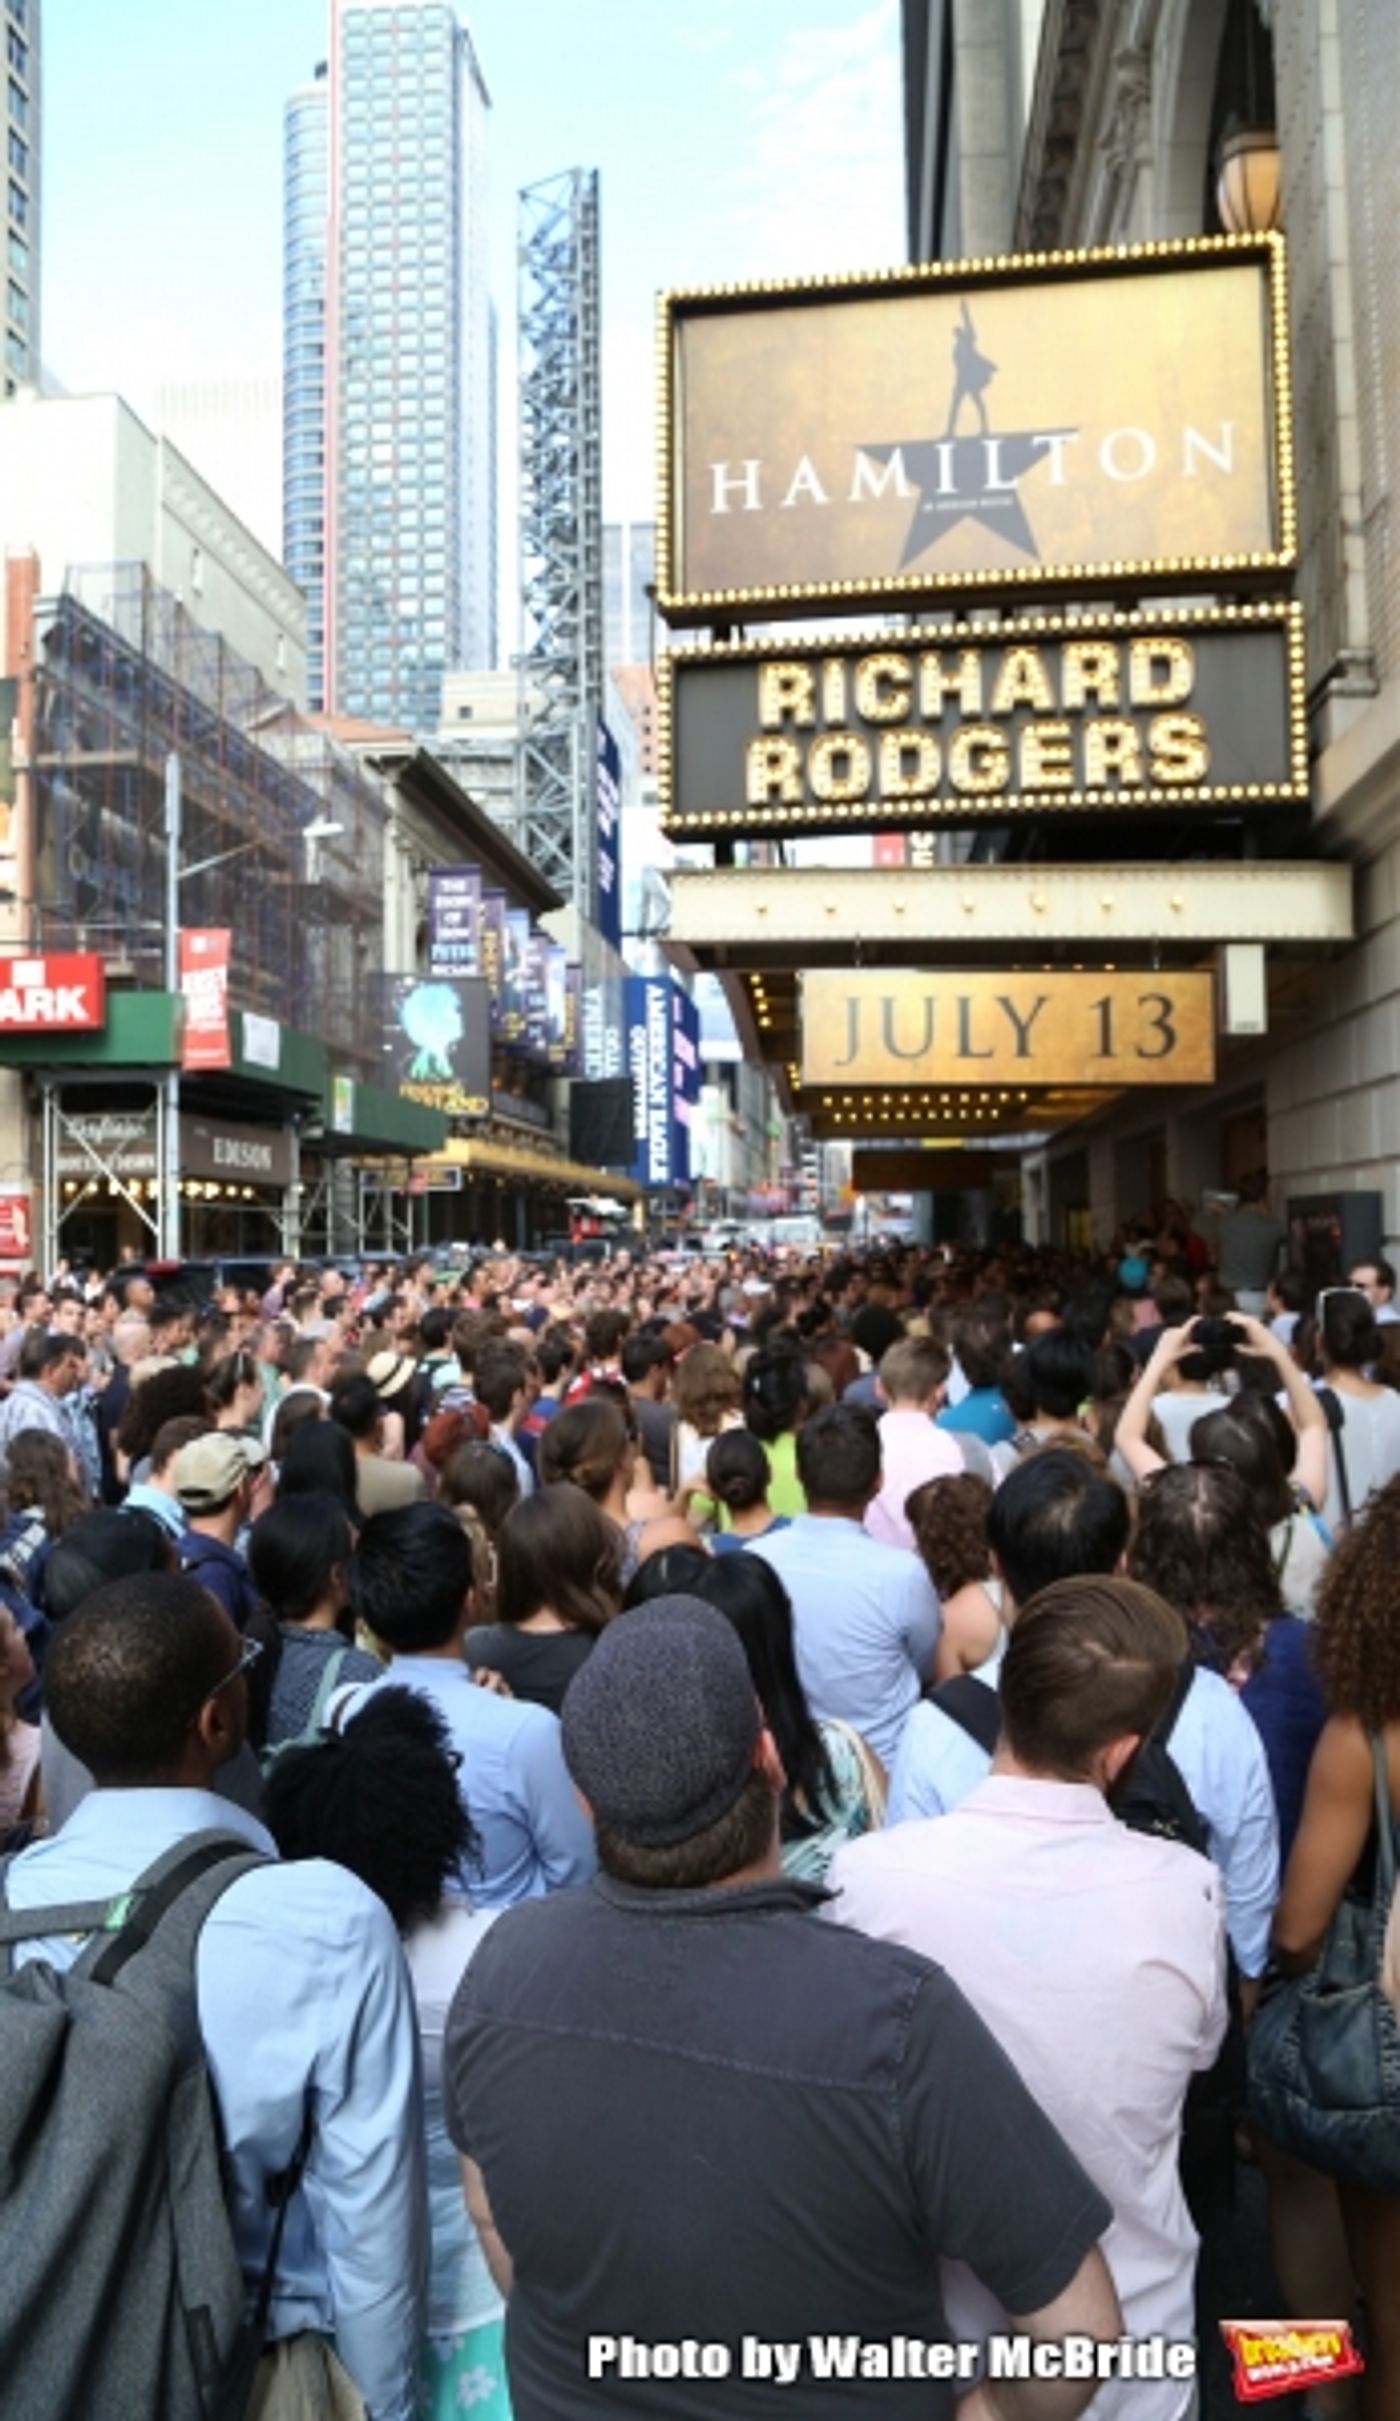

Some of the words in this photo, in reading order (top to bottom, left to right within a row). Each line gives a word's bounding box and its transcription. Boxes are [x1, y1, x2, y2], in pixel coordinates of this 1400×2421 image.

[709, 420, 1236, 514] HAMILTON
[758, 637, 1194, 728] RICHARD
[746, 712, 1210, 803] RODGERS
[0, 986, 88, 1022] ARK
[645, 984, 667, 1103] AMERICAN
[835, 995, 1049, 1067] JULY
[1089, 993, 1177, 1059] 13
[213, 1138, 272, 1170] EDISON
[649, 1109, 669, 1182] EAGLE
